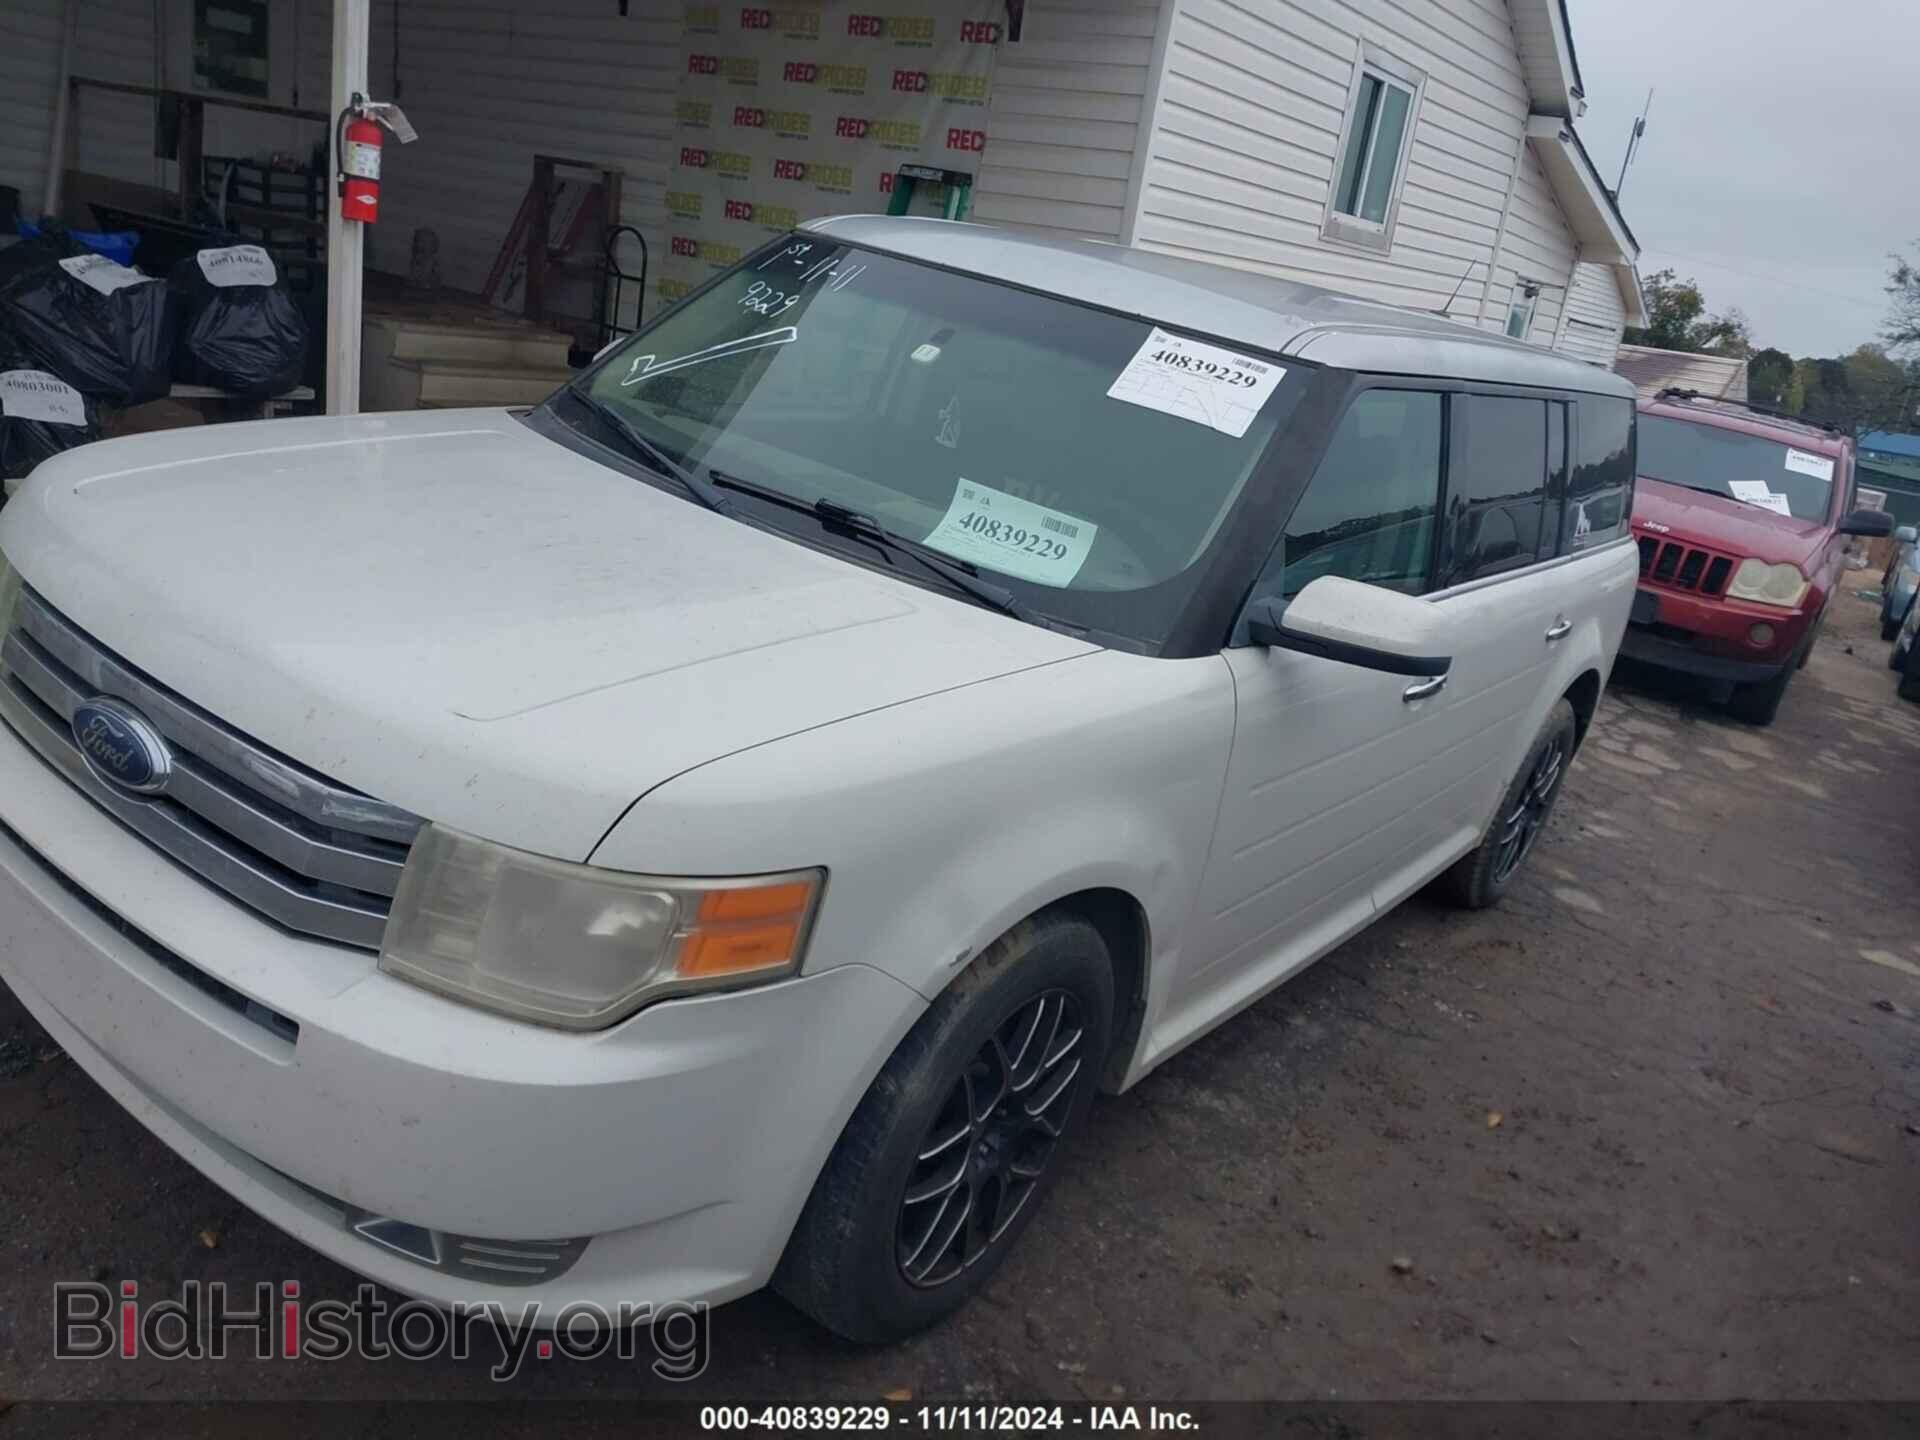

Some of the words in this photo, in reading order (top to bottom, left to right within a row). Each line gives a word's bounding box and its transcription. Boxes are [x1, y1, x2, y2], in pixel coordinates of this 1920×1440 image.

[1150, 349, 1258, 389] 40839229
[959, 511, 1068, 561] 40839229
[82, 715, 134, 771] Ford
